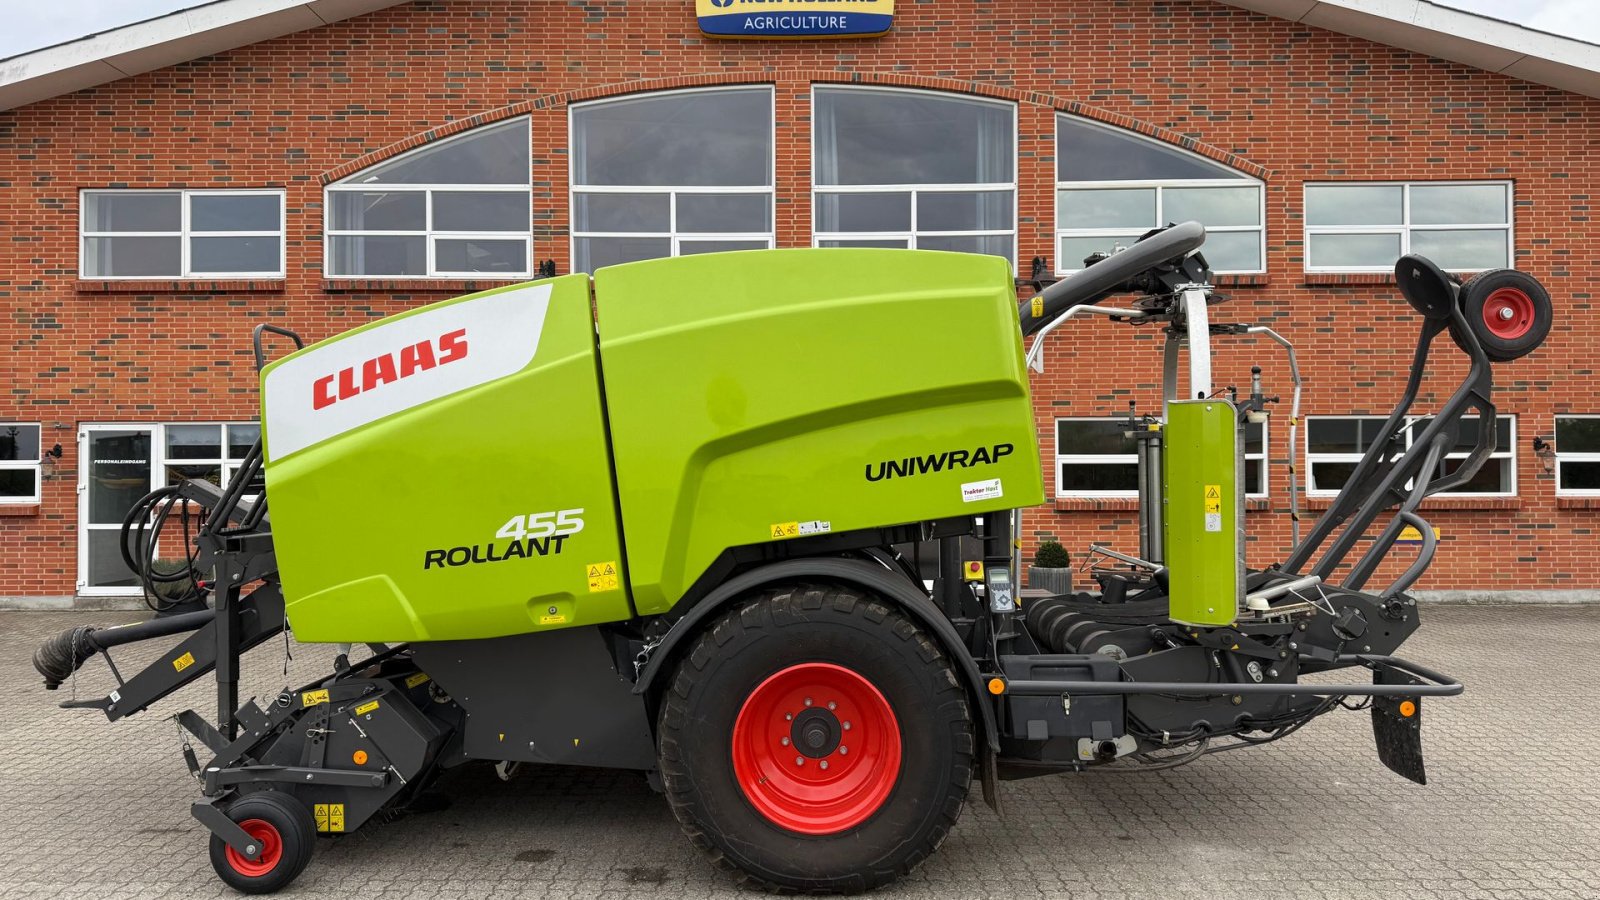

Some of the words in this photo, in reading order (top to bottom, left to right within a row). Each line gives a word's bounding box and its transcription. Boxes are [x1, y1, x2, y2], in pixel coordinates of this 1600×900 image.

[744, 16, 847, 30] AGRICULTURE
[313, 328, 468, 411] CLAAS
[865, 443, 1014, 482] UNIWRAP
[495, 507, 585, 541] 455
[424, 534, 570, 570] ROLLANT
